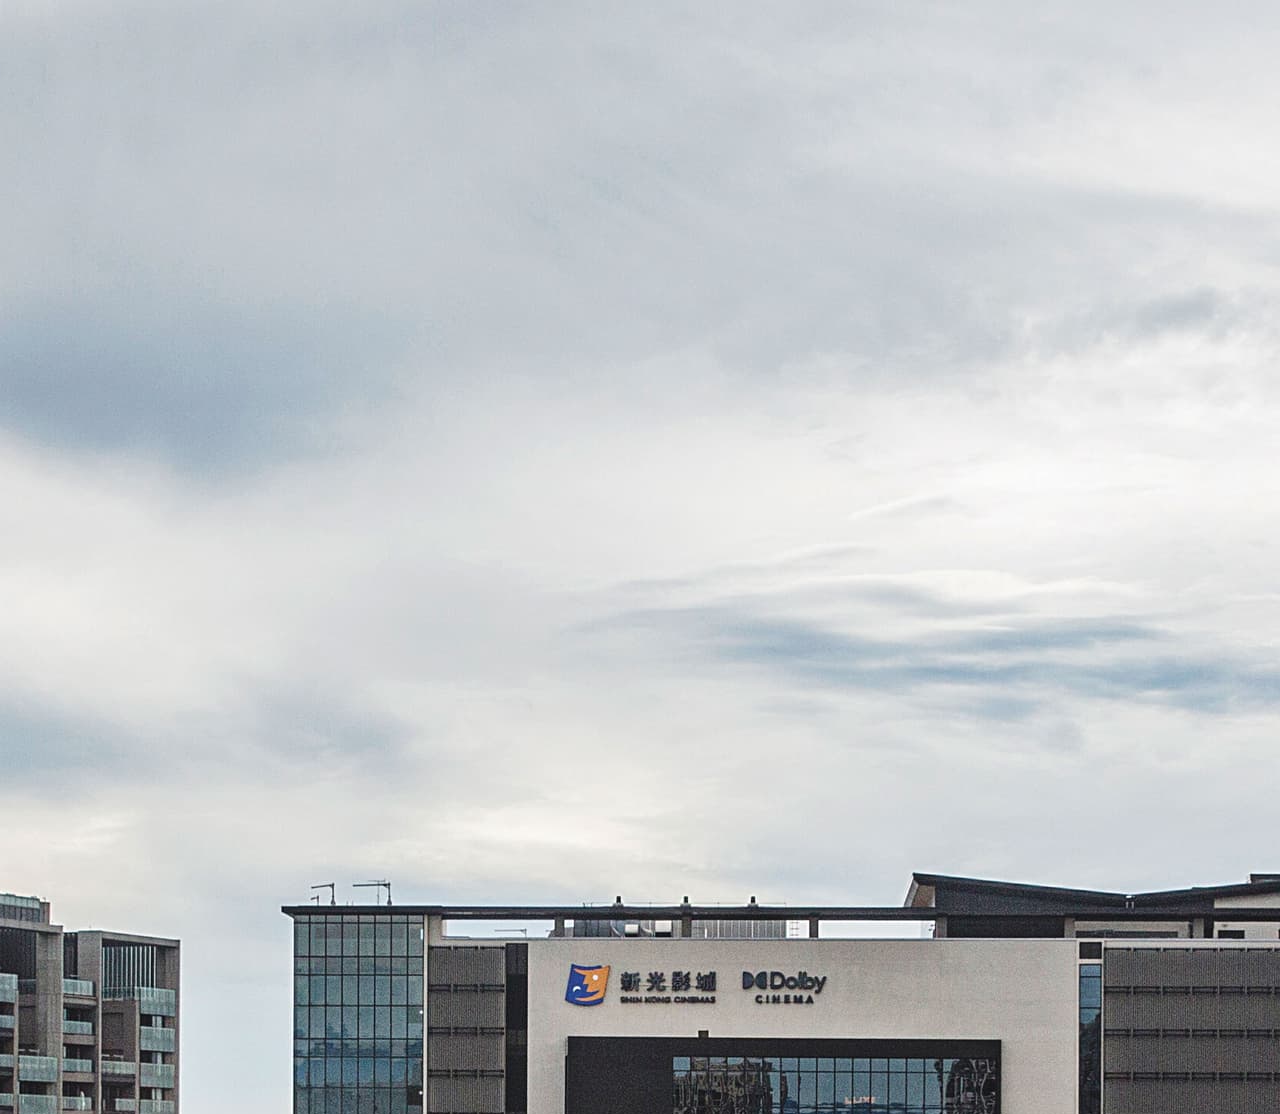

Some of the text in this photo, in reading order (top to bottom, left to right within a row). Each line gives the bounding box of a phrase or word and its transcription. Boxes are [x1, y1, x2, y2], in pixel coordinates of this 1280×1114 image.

[620, 971, 716, 992] 新光影城
[770, 971, 827, 994] Dolby
[674, 996, 716, 1004] CINEMAS
[755, 994, 815, 1004] CINEMA
